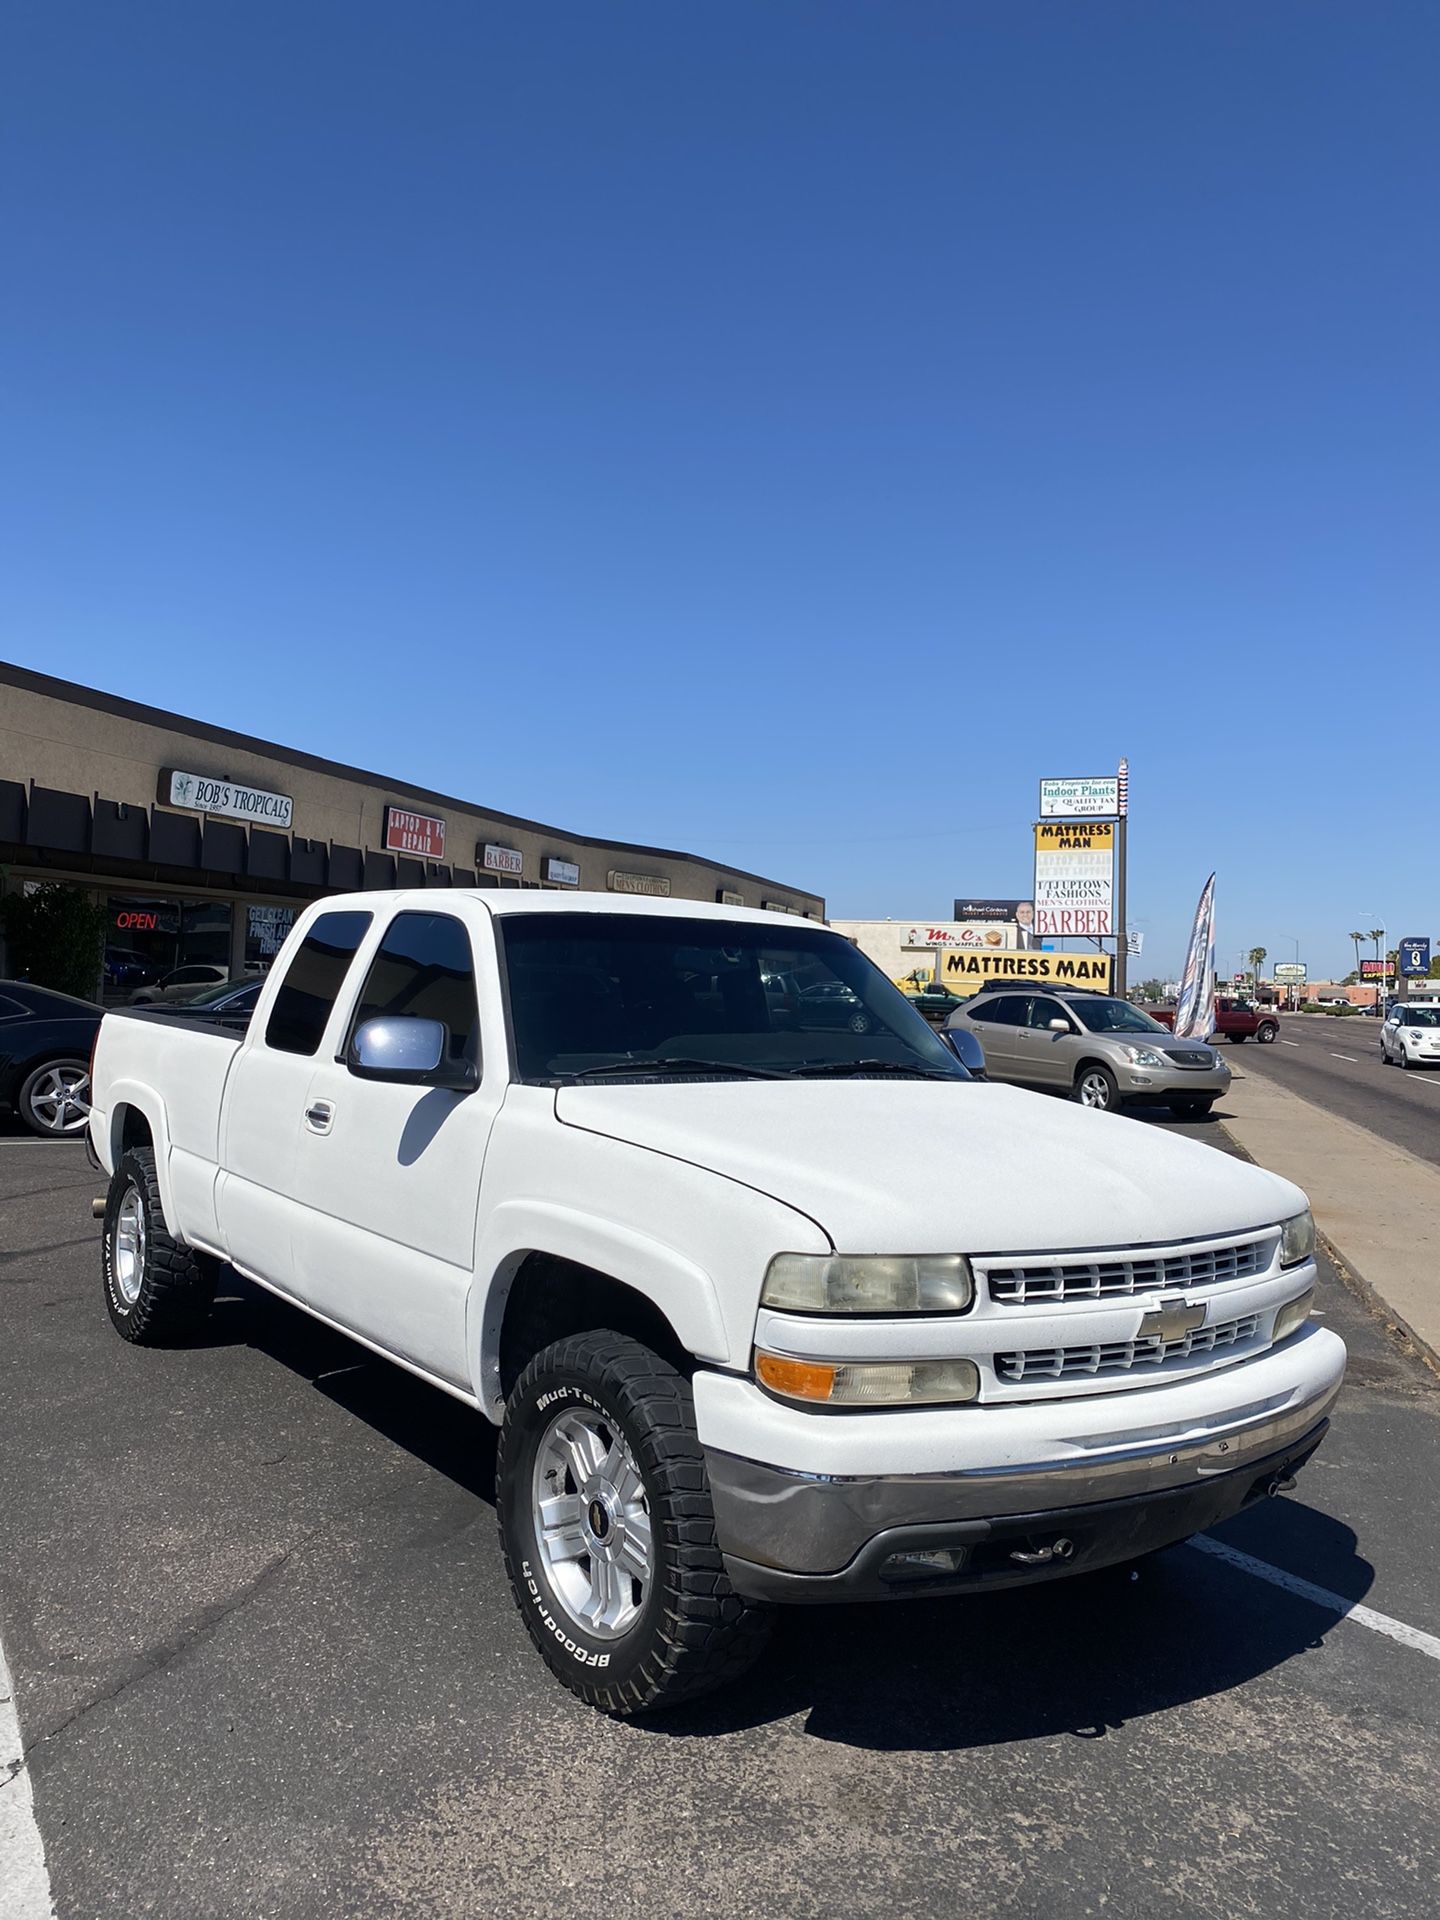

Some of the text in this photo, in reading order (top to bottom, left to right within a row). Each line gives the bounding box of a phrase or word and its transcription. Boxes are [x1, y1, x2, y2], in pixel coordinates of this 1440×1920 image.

[195, 781, 290, 819] BOB'S TROPICALS
[1043, 786, 1116, 796] Indoor Plants
[1062, 798, 1097, 806] QUALITY
[390, 812, 420, 833] LAPTOP
[426, 820, 432, 837] &
[1041, 824, 1112, 837] MATTRESS
[402, 832, 432, 853] REPAIR
[1058, 838, 1091, 849] MAN
[486, 851, 521, 872] BARBER
[1046, 889, 1102, 898] FASHIONS
[1062, 880, 1110, 889] UPTOWN
[117, 912, 159, 929] OPEN
[249, 921, 276, 938] FRESH
[1036, 909, 1110, 934] BARBER
[946, 955, 1106, 979] MATTRESS MAN
[536, 1386, 628, 1446] Mud-Terrai
[522, 1560, 611, 1668] BFGoodrich
